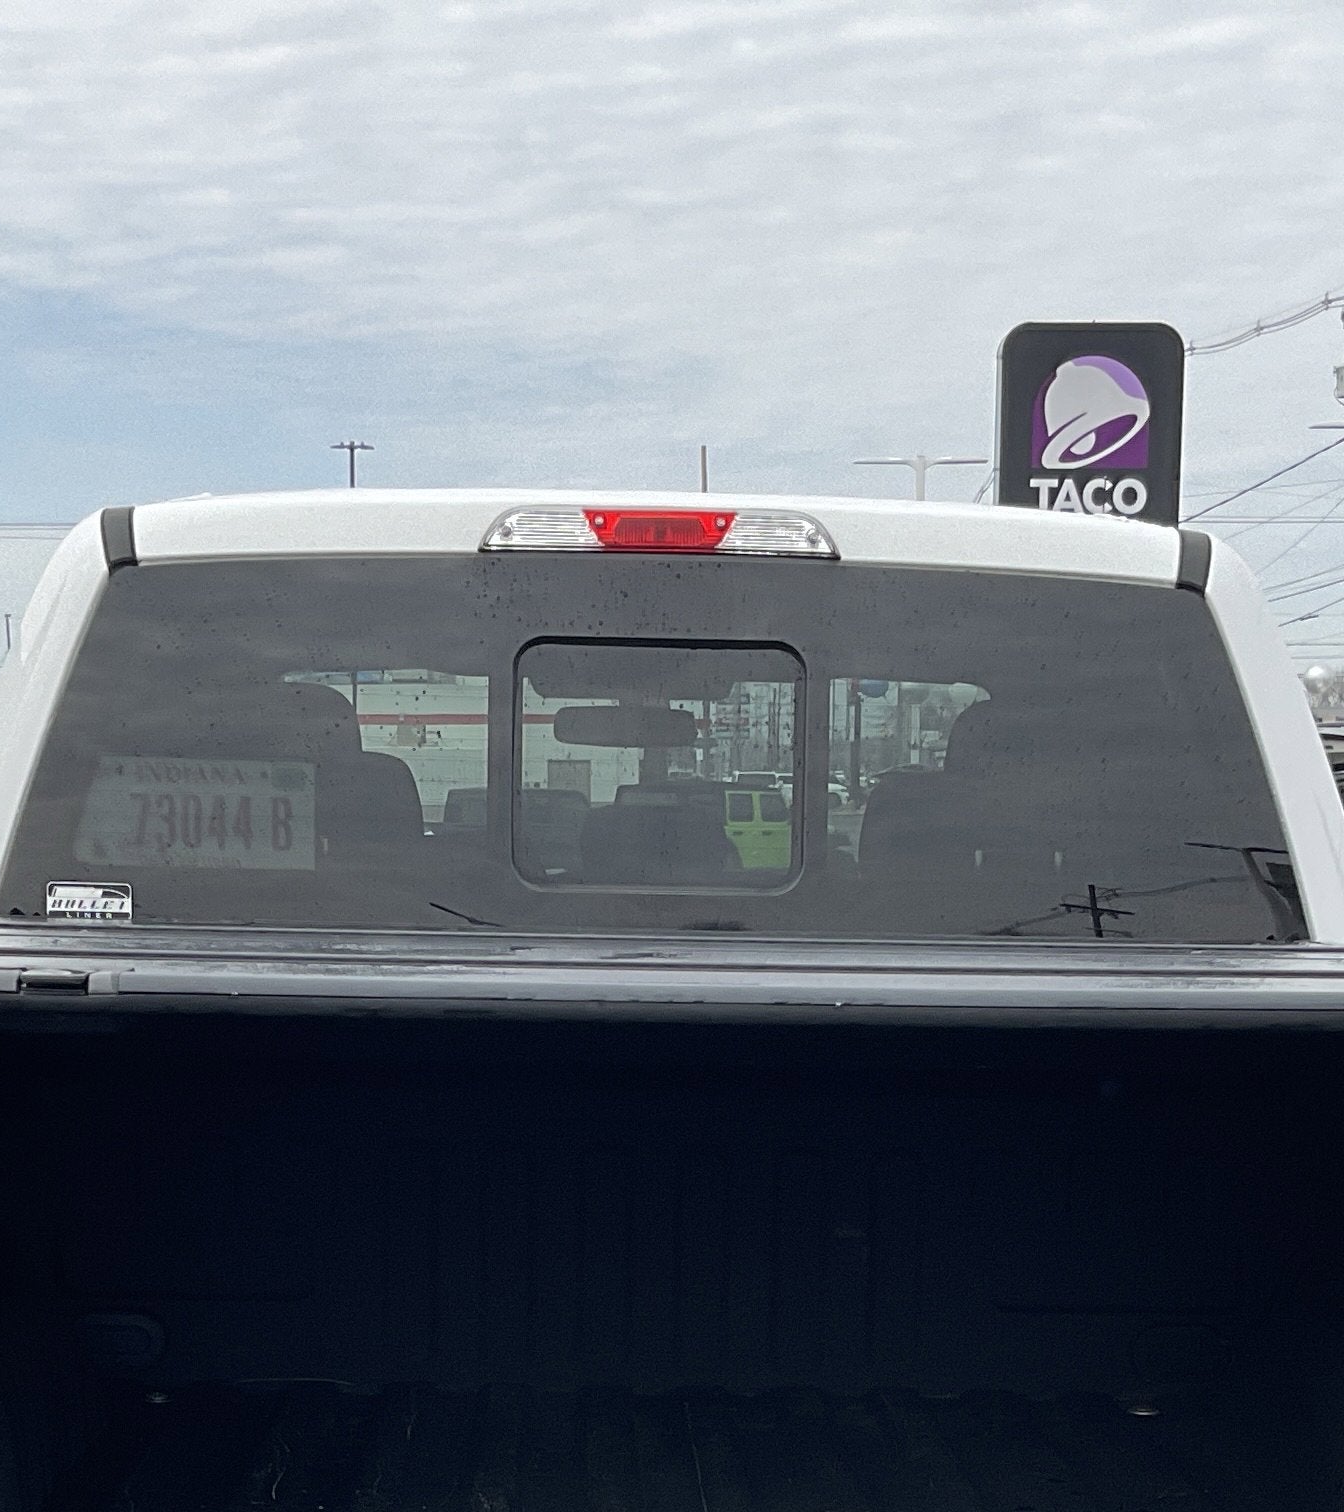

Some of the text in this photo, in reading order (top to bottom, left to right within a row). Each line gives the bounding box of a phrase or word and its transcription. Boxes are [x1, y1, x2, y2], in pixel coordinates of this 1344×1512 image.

[1030, 477, 1147, 514] TACO
[135, 761, 247, 785] INDIANA
[51, 899, 127, 910] BULLET
[64, 911, 113, 919] LINER
